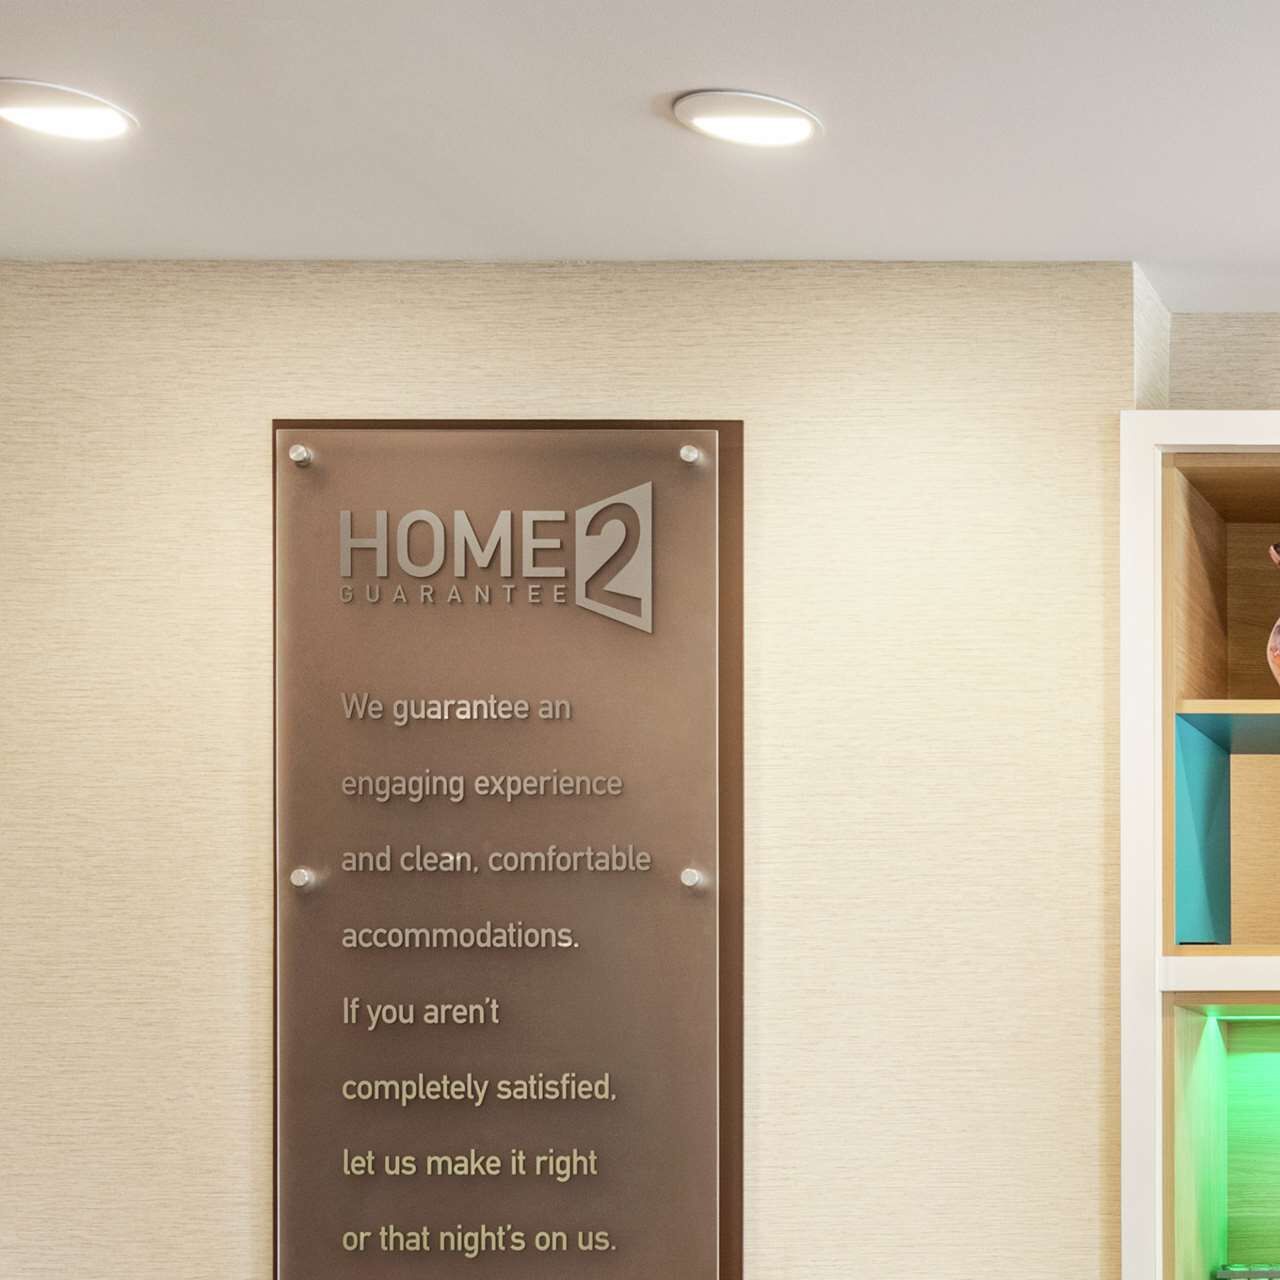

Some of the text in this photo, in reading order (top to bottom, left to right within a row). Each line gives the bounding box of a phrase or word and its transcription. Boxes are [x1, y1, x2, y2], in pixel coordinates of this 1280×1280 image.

[339, 509, 566, 578] HOME
[339, 584, 567, 604] GUARANTEE
[340, 693, 572, 727] We guarantee an
[341, 770, 624, 802] engaging experience
[341, 845, 652, 874] and clean, comfortable
[341, 921, 580, 948] accommodations.
[343, 997, 500, 1031] If you aren’t
[341, 1073, 617, 1106] completely satisfied,
[343, 1149, 598, 1183] let us make it right
[341, 1224, 617, 1258] or that night’s on us.
